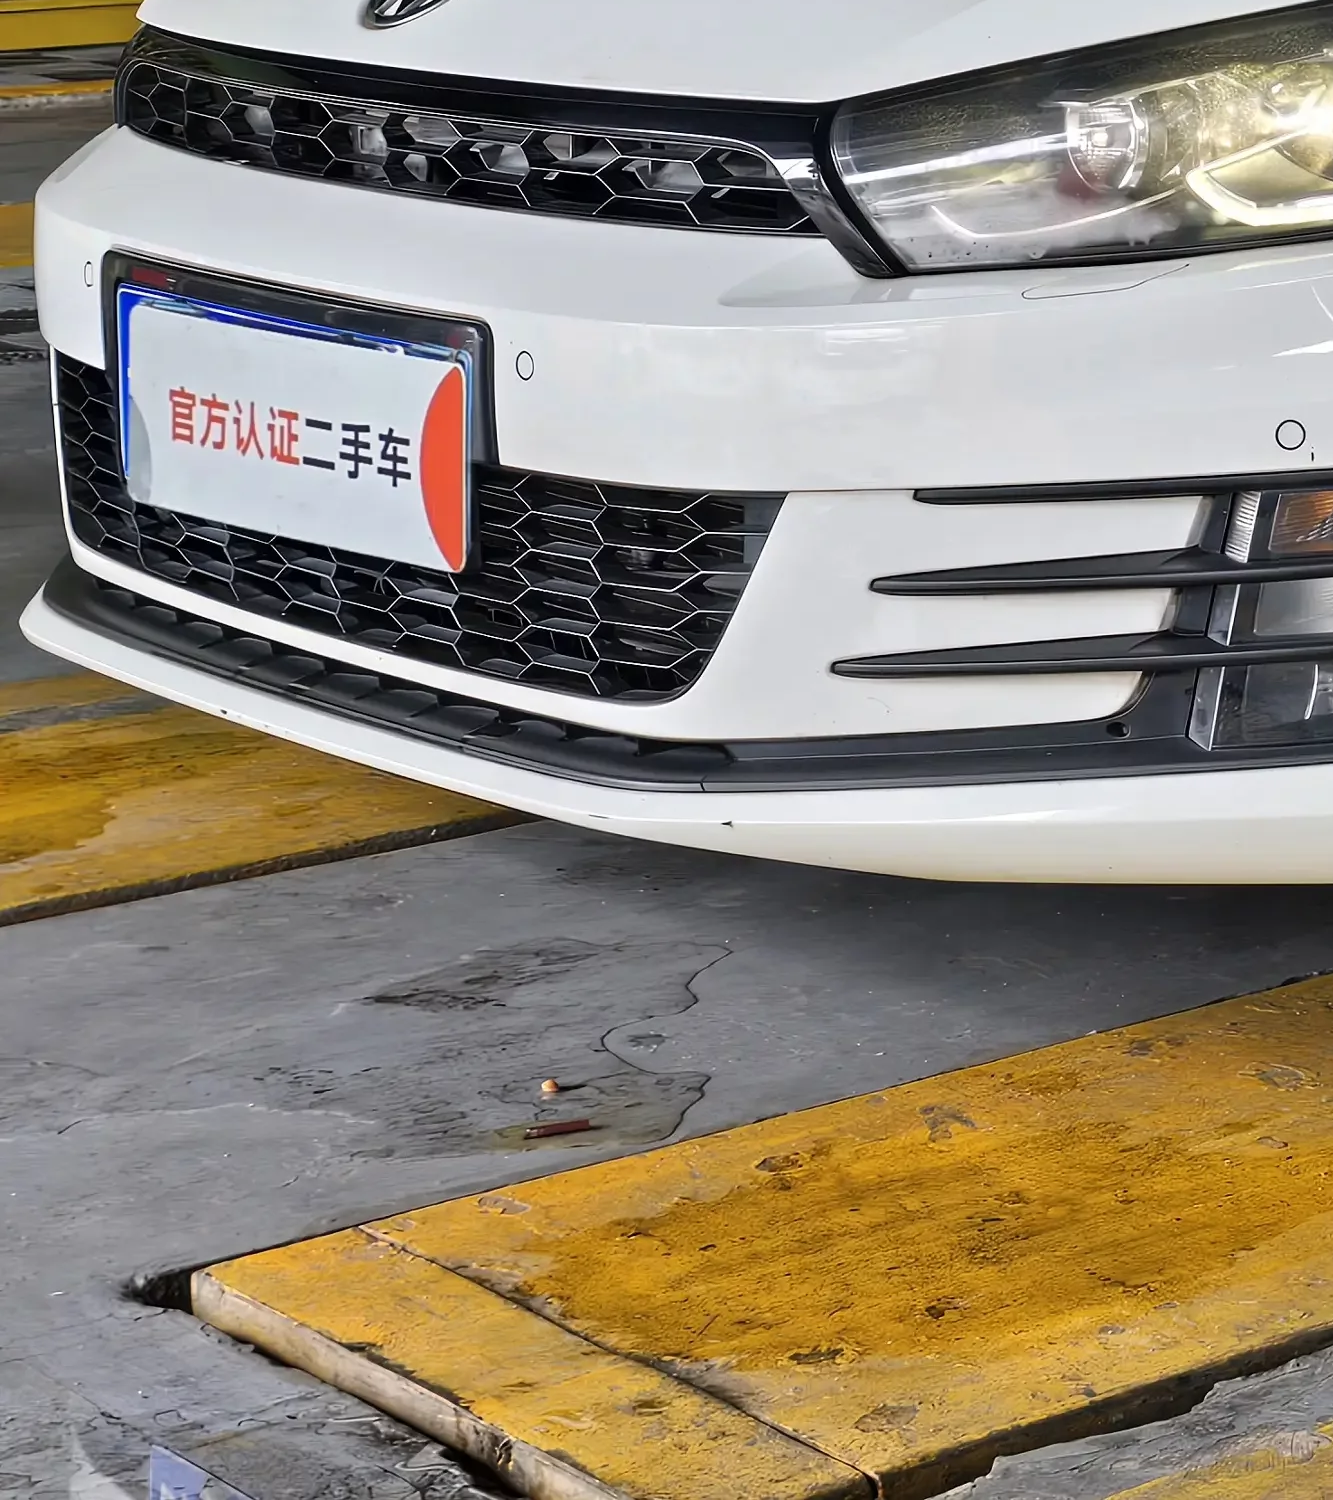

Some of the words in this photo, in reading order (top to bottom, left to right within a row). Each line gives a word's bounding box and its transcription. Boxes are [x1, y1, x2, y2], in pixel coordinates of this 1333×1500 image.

[168, 386, 412, 488] 官方认证二手车
